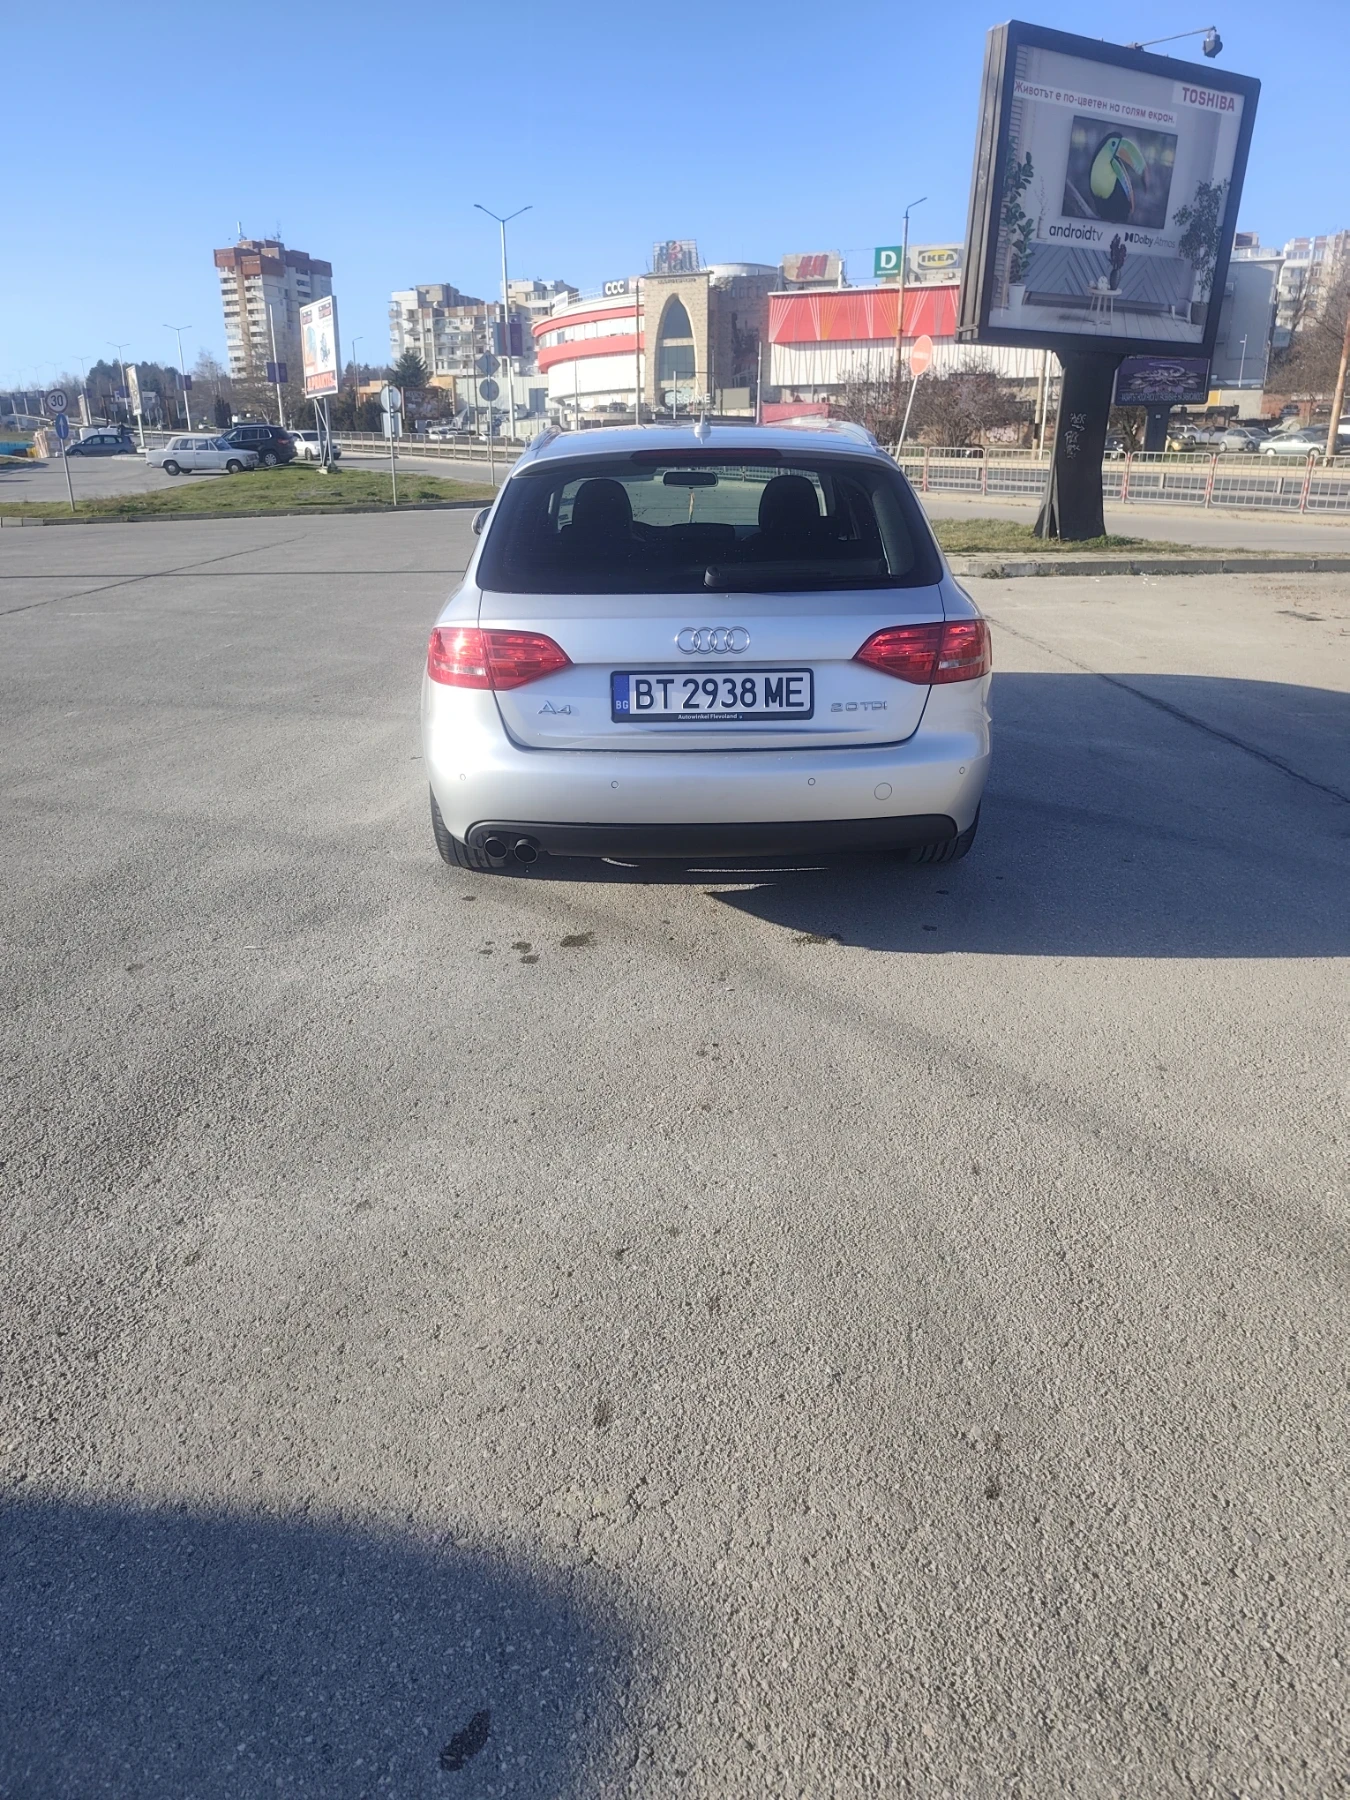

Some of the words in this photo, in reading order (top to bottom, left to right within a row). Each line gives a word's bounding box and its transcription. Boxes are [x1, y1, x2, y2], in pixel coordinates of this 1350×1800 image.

[1014, 81, 1053, 99] Животът
[1055, 93, 1062, 101] е
[1063, 94, 1108, 110] по-цветен
[1109, 104, 1120, 113] на
[1121, 107, 1146, 118] голям
[1148, 111, 1175, 125] екран.
[1182, 86, 1235, 112] TOSHIBA
[1134, 233, 1154, 248] Dolby
[1154, 236, 1176, 249] Atmos
[880, 250, 897, 269] D
[921, 254, 955, 263] IKEA
[604, 280, 625, 296] CCC
[50, 394, 64, 407] 30
[635, 679, 675, 710] BT
[682, 677, 757, 709] 2938
[764, 676, 805, 708] ME
[536, 700, 572, 715] A4
[615, 700, 629, 710] BG
